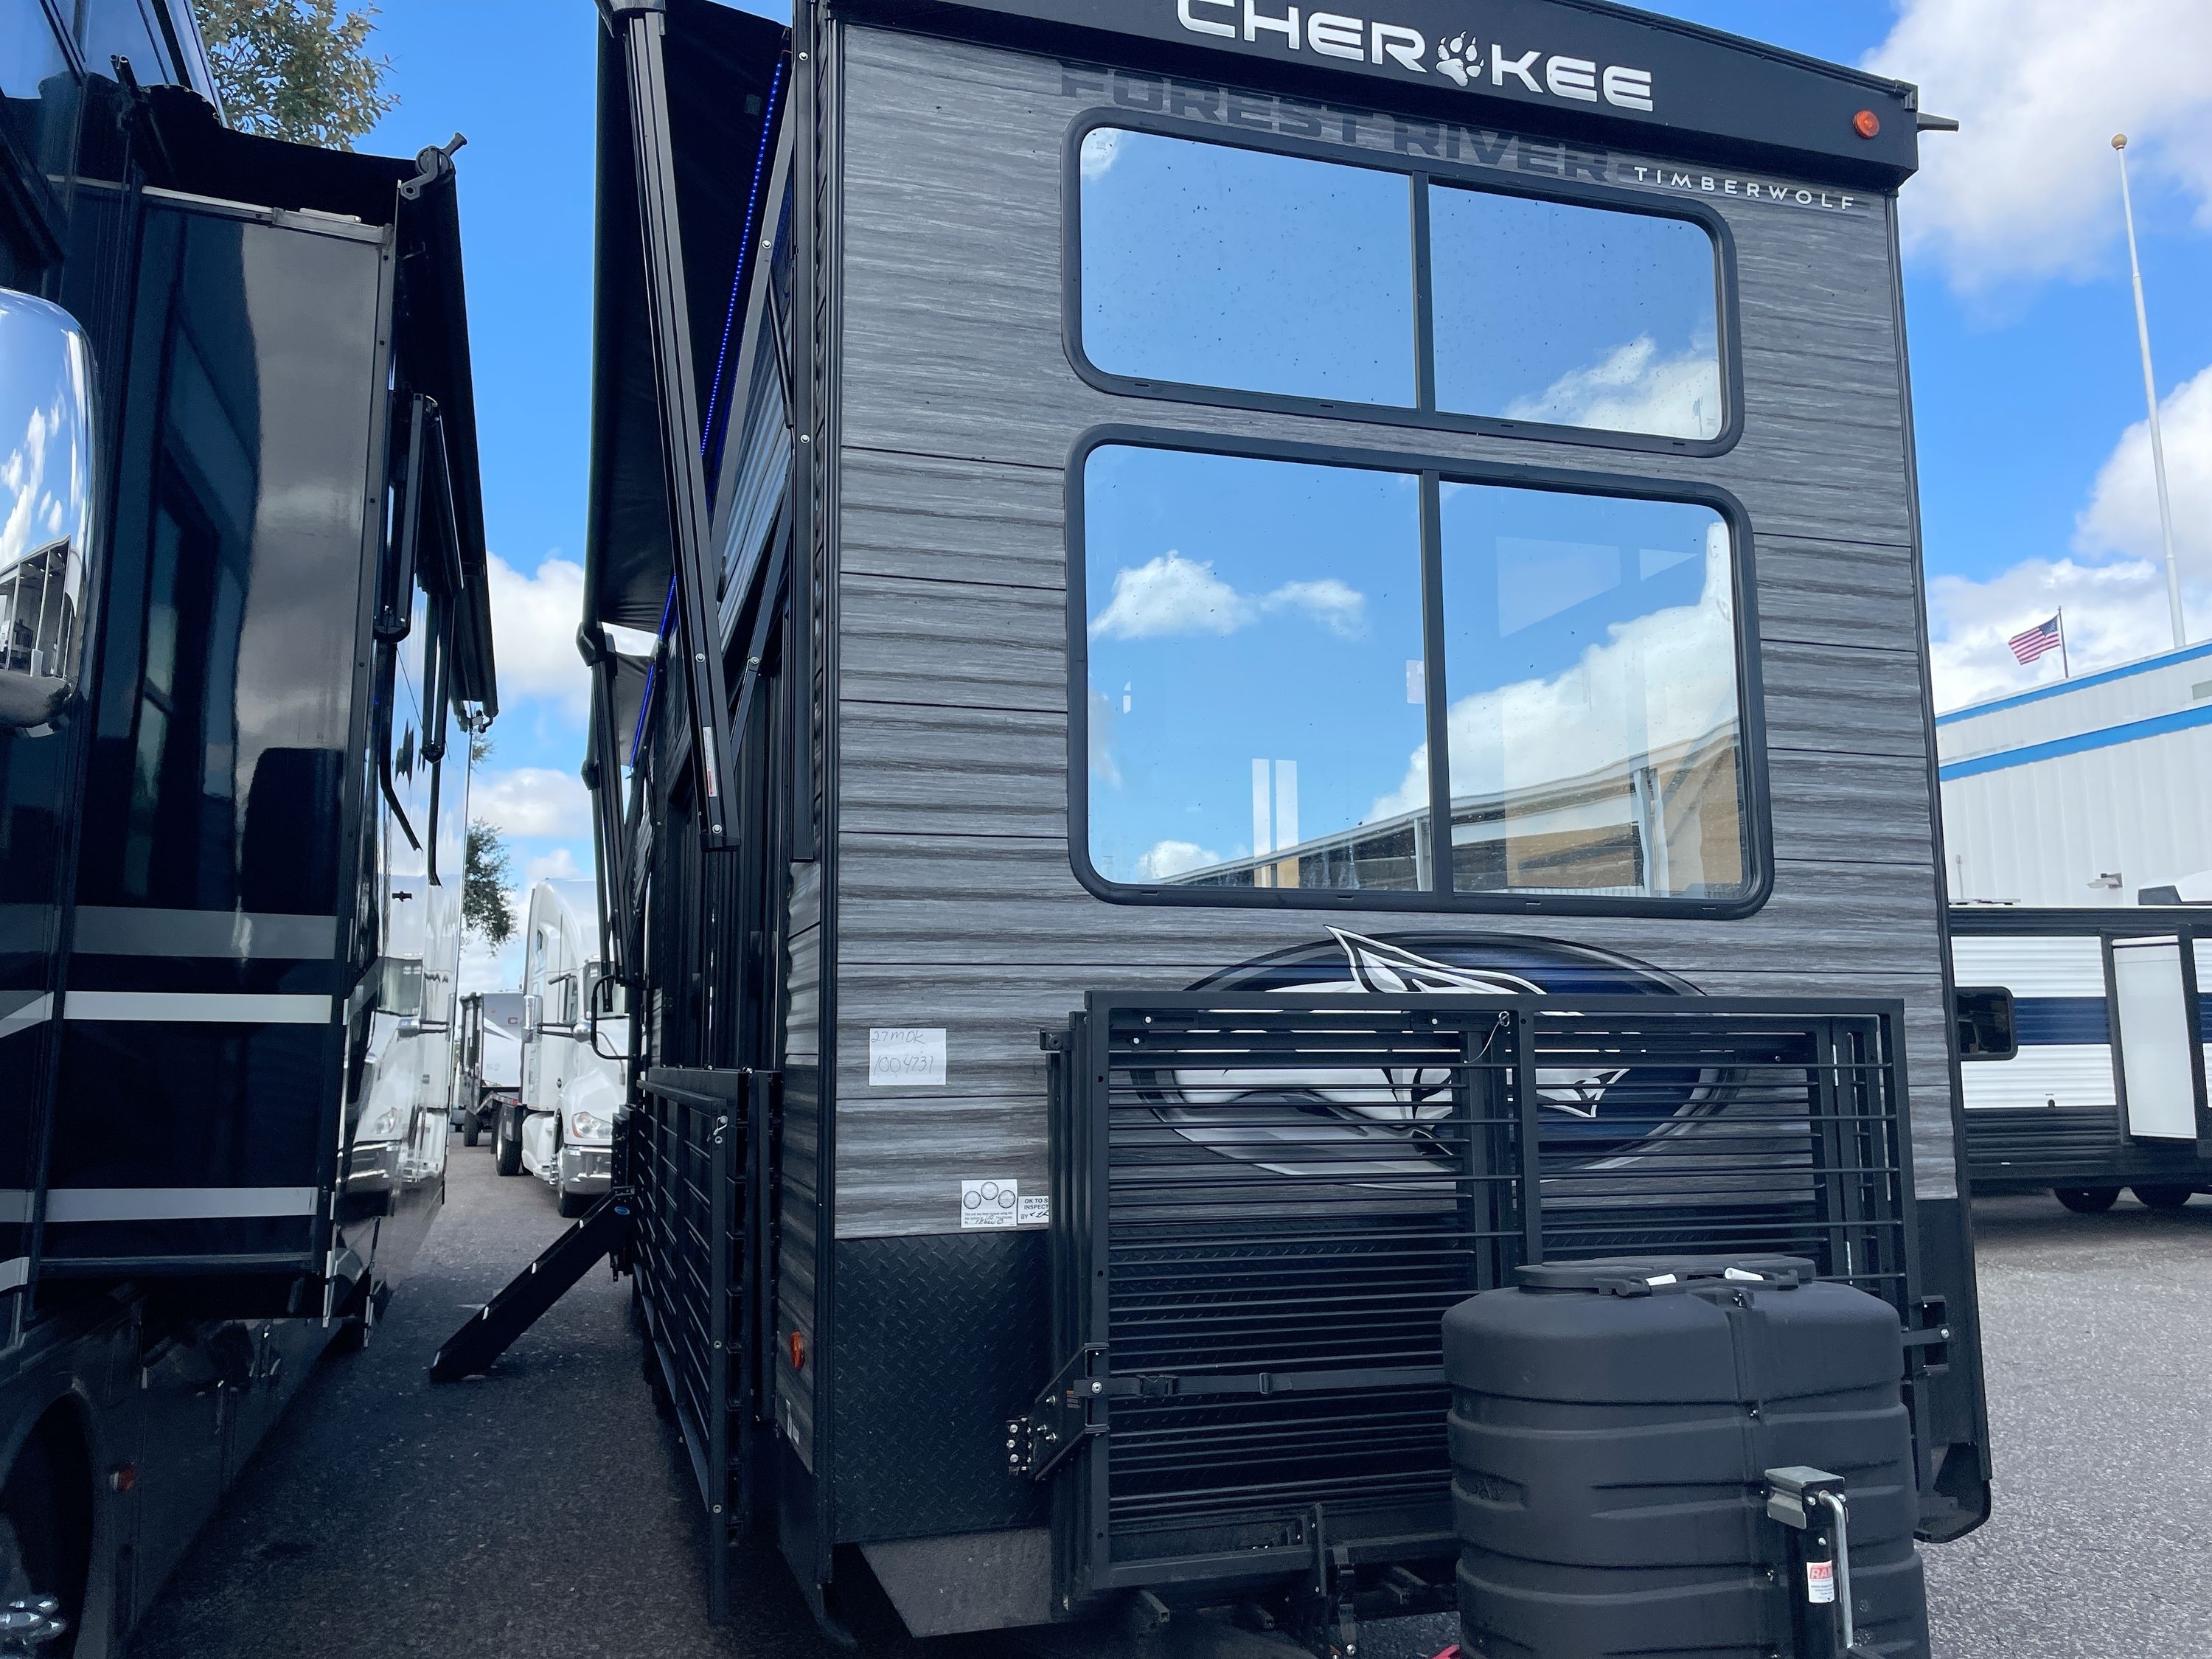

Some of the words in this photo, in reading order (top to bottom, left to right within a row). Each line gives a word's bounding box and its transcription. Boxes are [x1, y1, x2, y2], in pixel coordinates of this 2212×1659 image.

[1062, 63, 1373, 142] FOREST
[1394, 115, 1609, 182] RIVER
[1634, 166, 1854, 210] TIMBERWOLF
